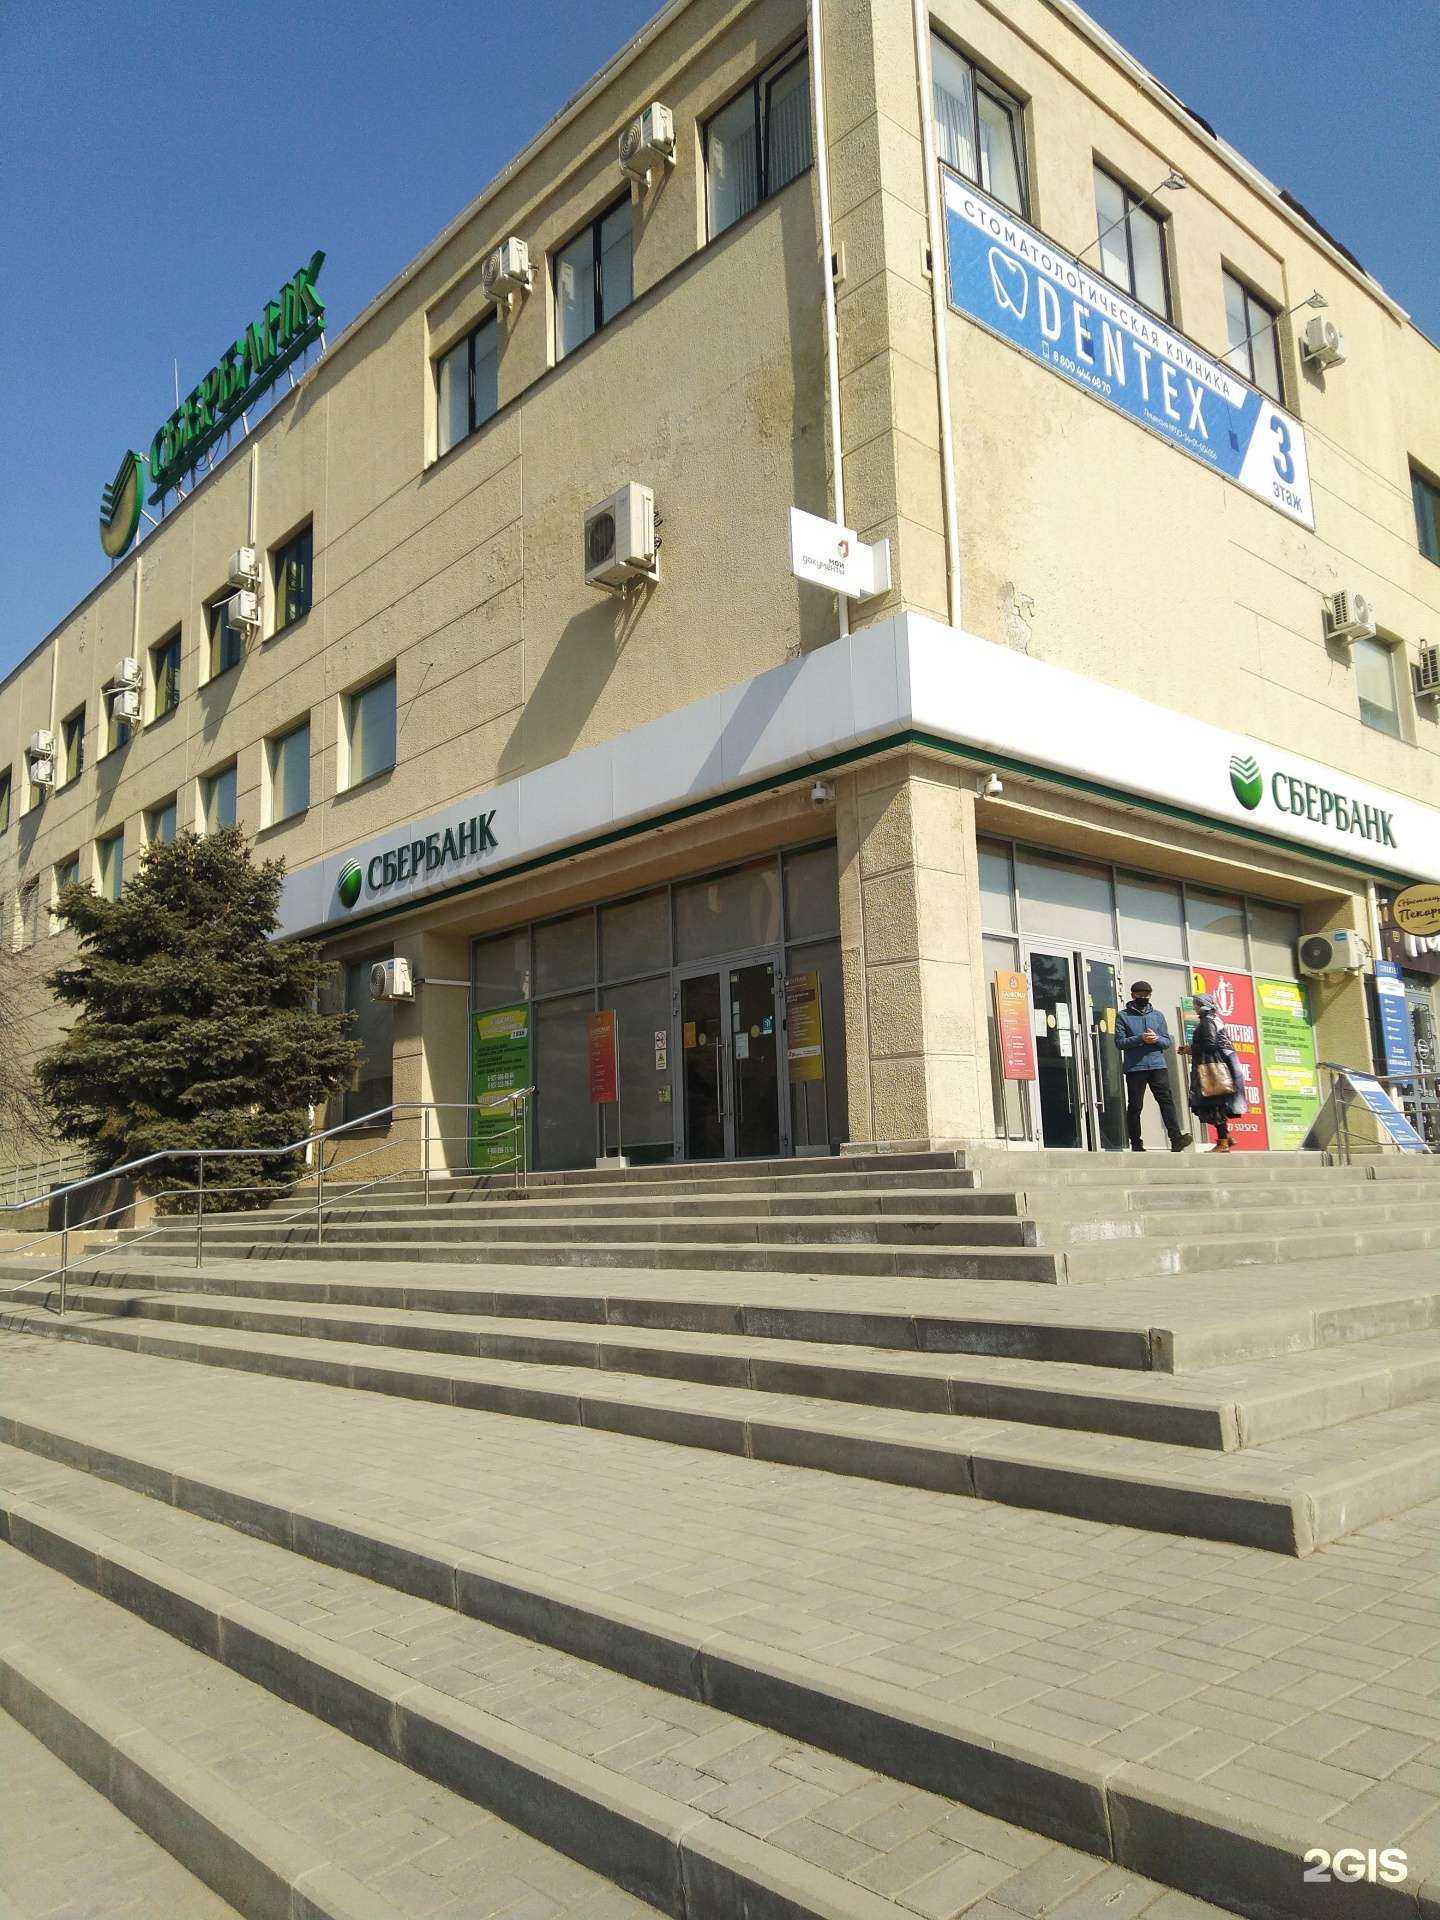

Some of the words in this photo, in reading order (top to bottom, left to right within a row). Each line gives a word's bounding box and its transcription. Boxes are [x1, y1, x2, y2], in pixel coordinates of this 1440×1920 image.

[964, 200, 1159, 347] СТОМАТОЛОГИЧЕСКАЯ
[1166, 341, 1231, 395] КЛИНИКА
[1037, 275, 1208, 439] DENTEX
[1270, 414, 1295, 484] 3
[367, 809, 499, 891] СБЕРБАНК
[1271, 772, 1398, 848] СБЕРБАНК
